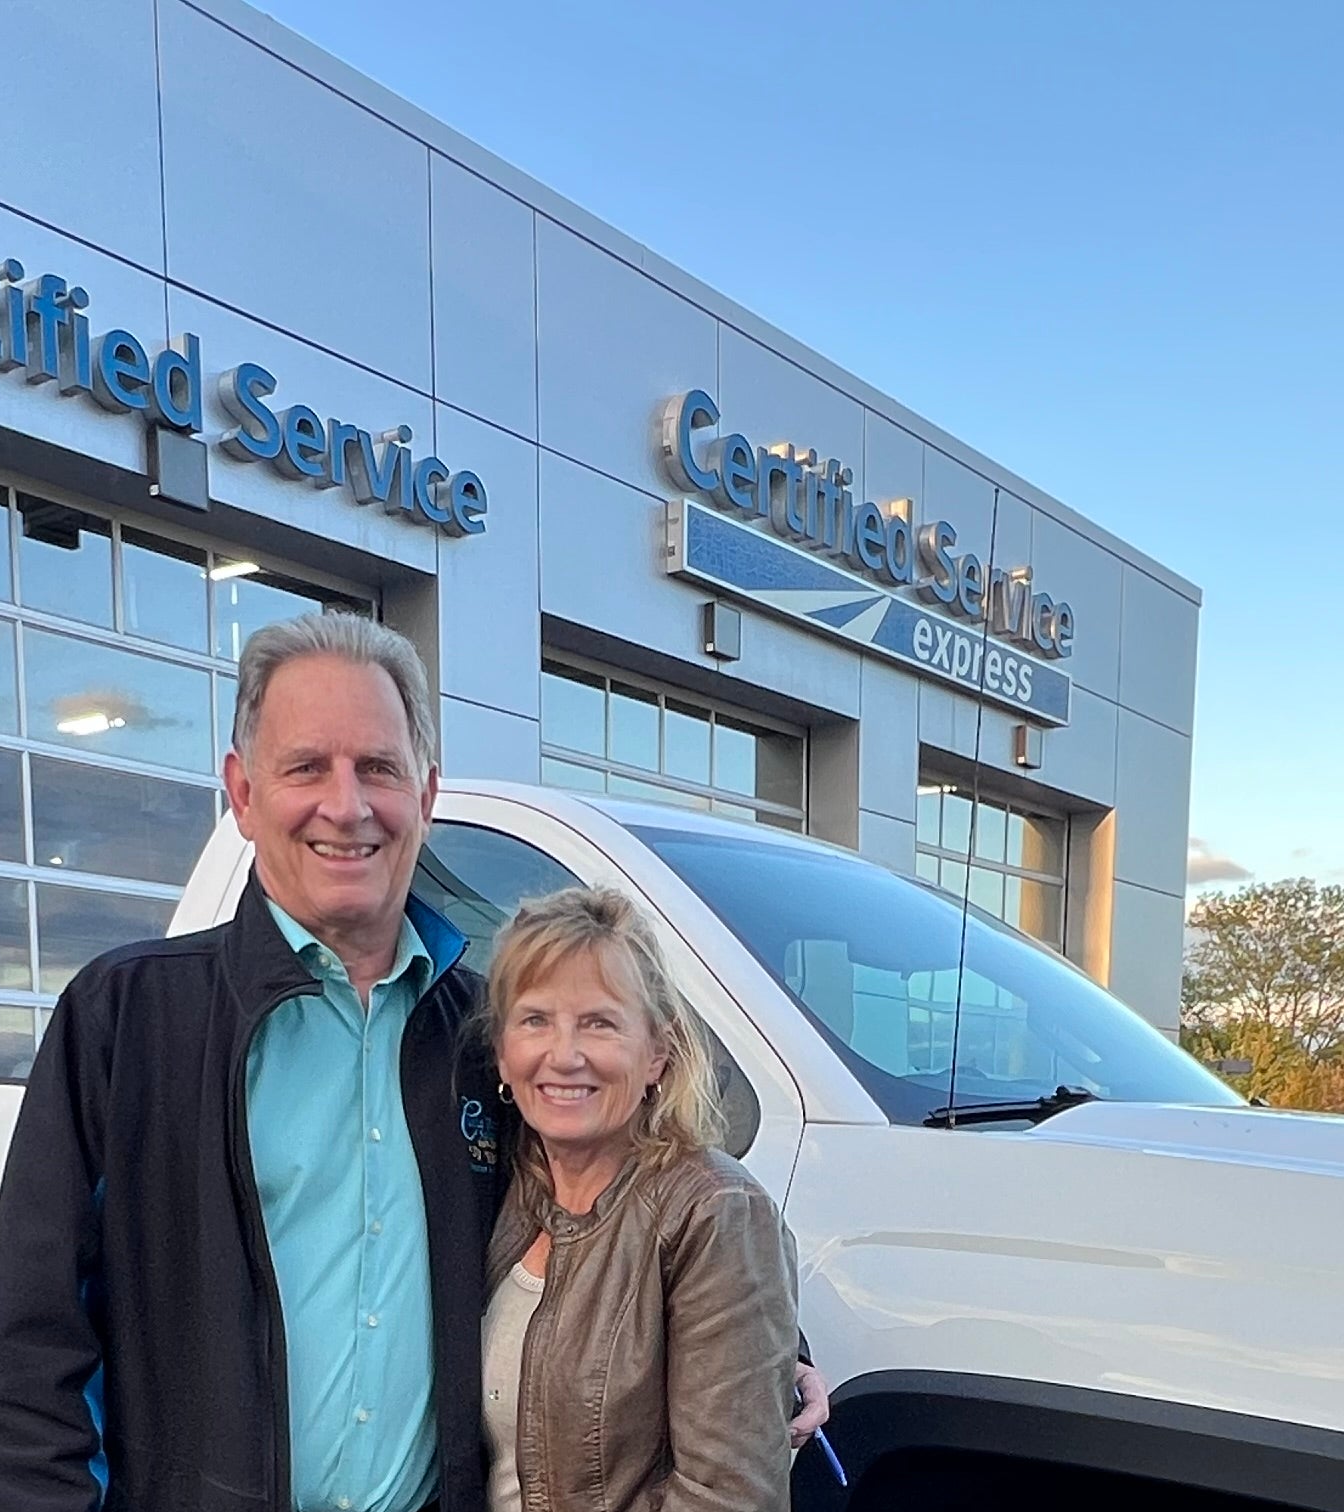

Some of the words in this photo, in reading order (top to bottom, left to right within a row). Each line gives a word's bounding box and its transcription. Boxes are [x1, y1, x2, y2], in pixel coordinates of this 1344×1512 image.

[224, 361, 488, 537] Service
[670, 389, 914, 585] Certified
[922, 519, 1075, 660] Service
[912, 617, 1034, 703] express
